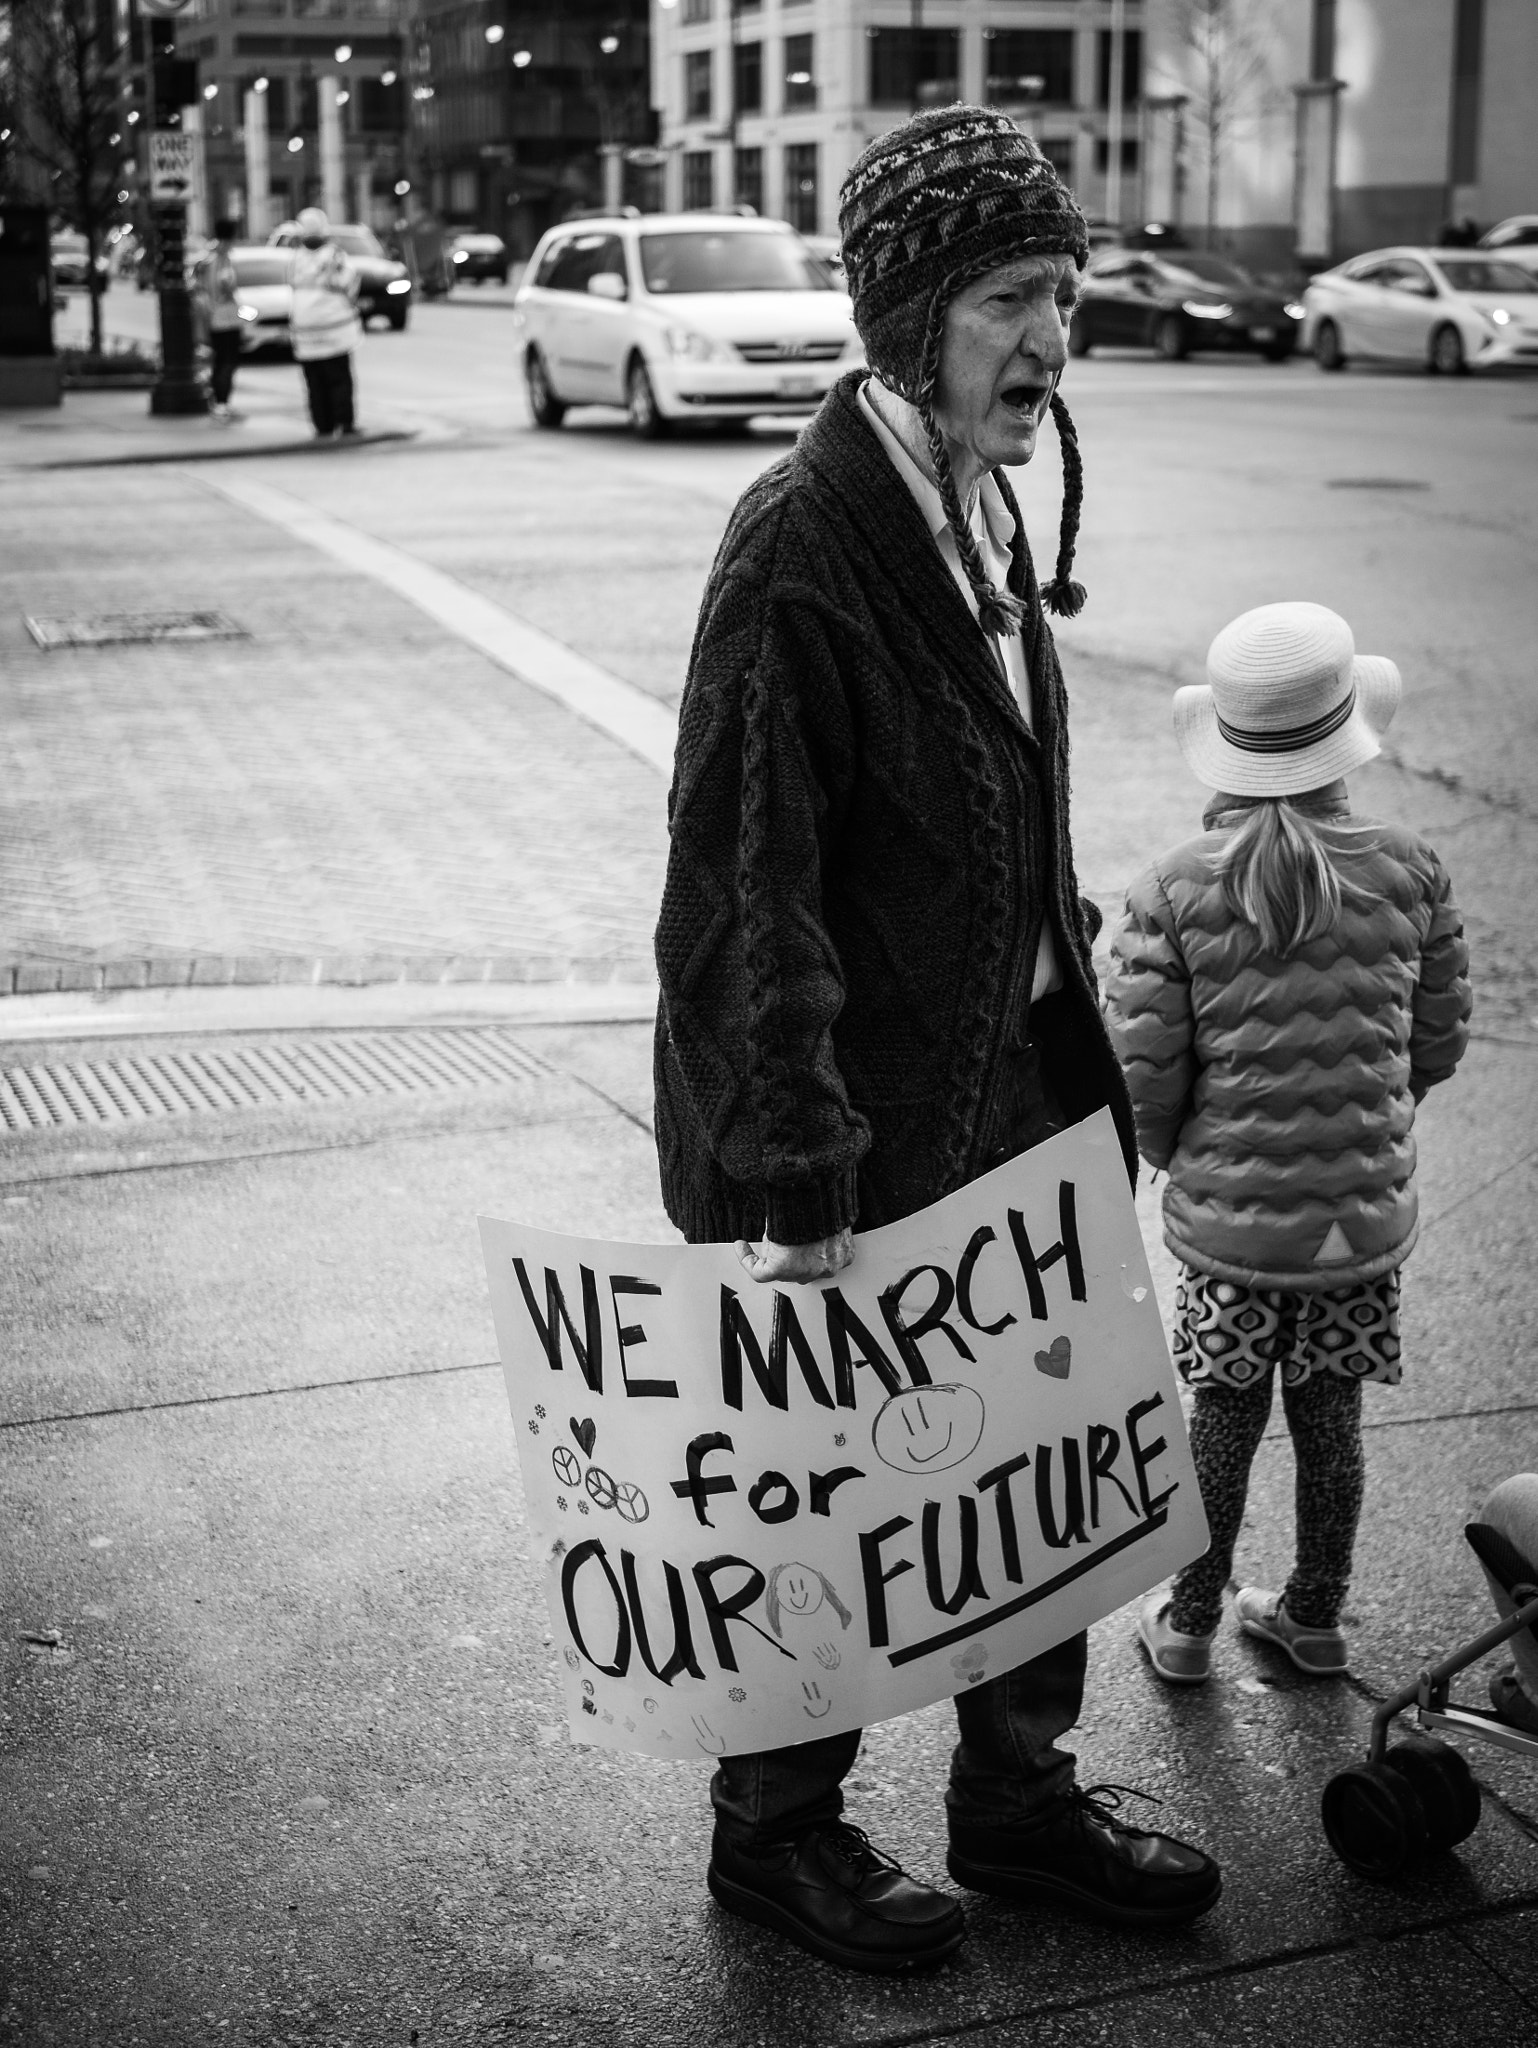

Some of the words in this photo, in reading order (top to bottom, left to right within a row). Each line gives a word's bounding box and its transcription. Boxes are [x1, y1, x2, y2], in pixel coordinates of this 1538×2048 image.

[511, 1257, 679, 1398] WE
[719, 1179, 1088, 1412] MARCH
[560, 1538, 798, 1687] OUR
[857, 1391, 1181, 1650] FUTURE
[669, 1431, 867, 1528] for
